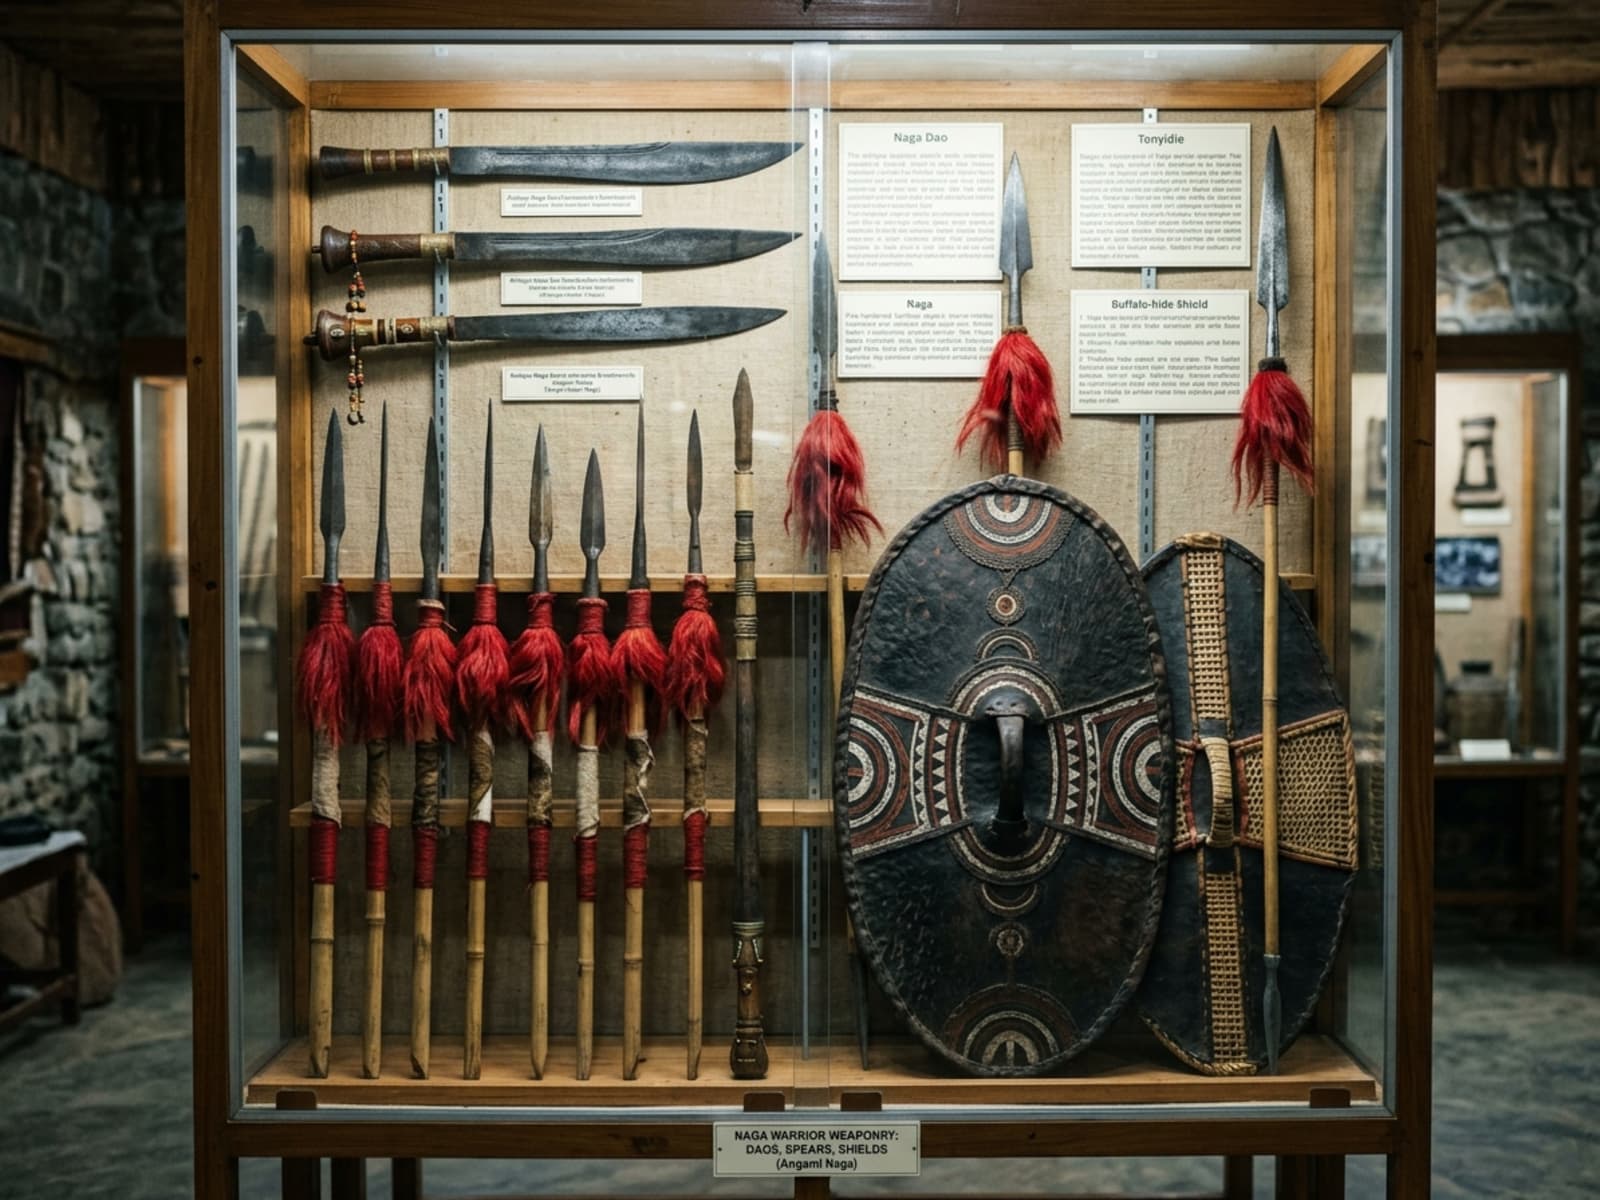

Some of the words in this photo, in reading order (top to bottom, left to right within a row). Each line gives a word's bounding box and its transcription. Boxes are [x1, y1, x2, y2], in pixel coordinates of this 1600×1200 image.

[893, 132, 923, 145] Naga
[926, 132, 949, 143] Dao
[1138, 133, 1185, 146] Tonyidie
[906, 299, 933, 310] Naga
[735, 1130, 769, 1141] NAGA
[770, 1130, 827, 1141] WARRIOR
[829, 1130, 899, 1141] WEAPONRY:
[746, 1144, 783, 1156] DAOS,
[785, 1144, 835, 1156] SPEARS,
[838, 1144, 889, 1155] SHIELDS
[825, 1157, 858, 1171] Naga)
